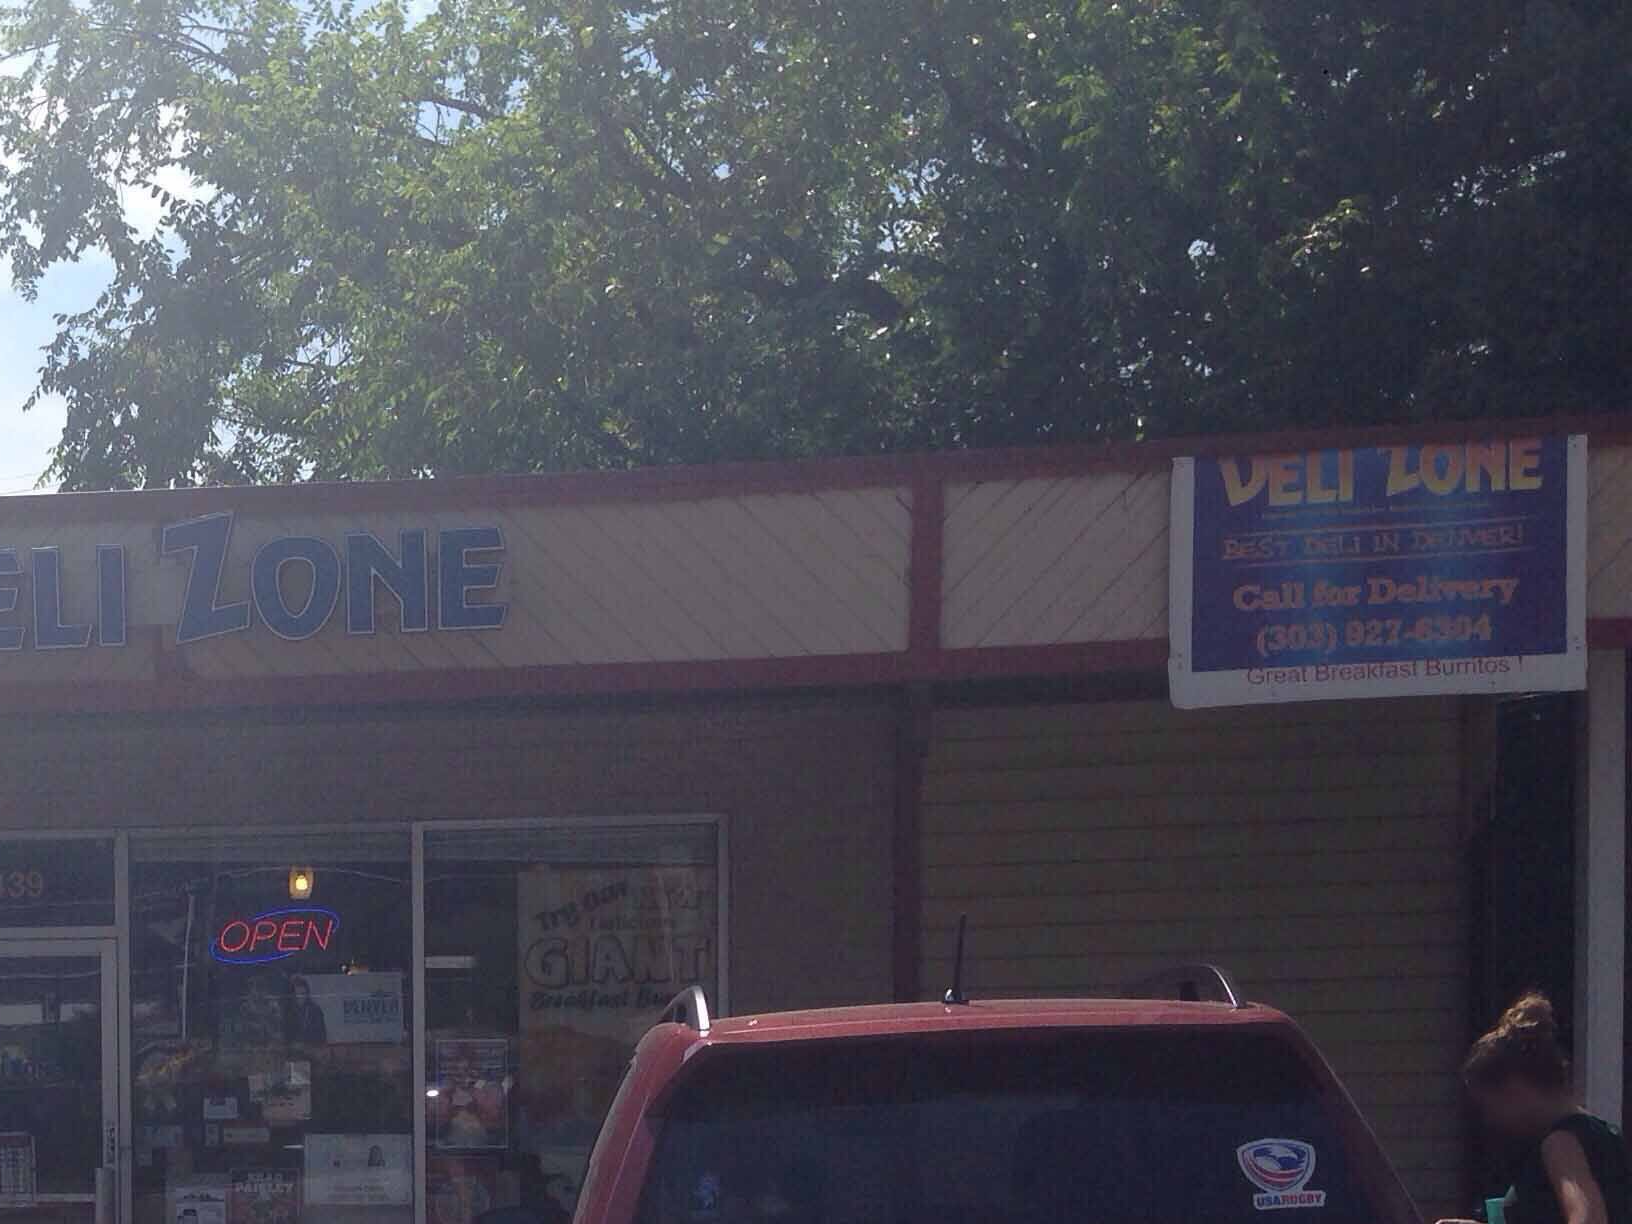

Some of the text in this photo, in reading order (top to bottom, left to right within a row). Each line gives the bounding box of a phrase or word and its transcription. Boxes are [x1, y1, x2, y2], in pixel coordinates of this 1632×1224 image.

[1218, 437, 1544, 506] DELI ZONE
[1373, 530, 1401, 553] IN
[160, 510, 507, 645] ZONE
[1231, 575, 1520, 612] Call for Delivery
[1246, 663, 1310, 686] Great
[1314, 659, 1418, 683] Breakfast
[1424, 655, 1512, 678] Burritos
[220, 919, 334, 953] OPEN
[524, 933, 716, 989] GIANT
